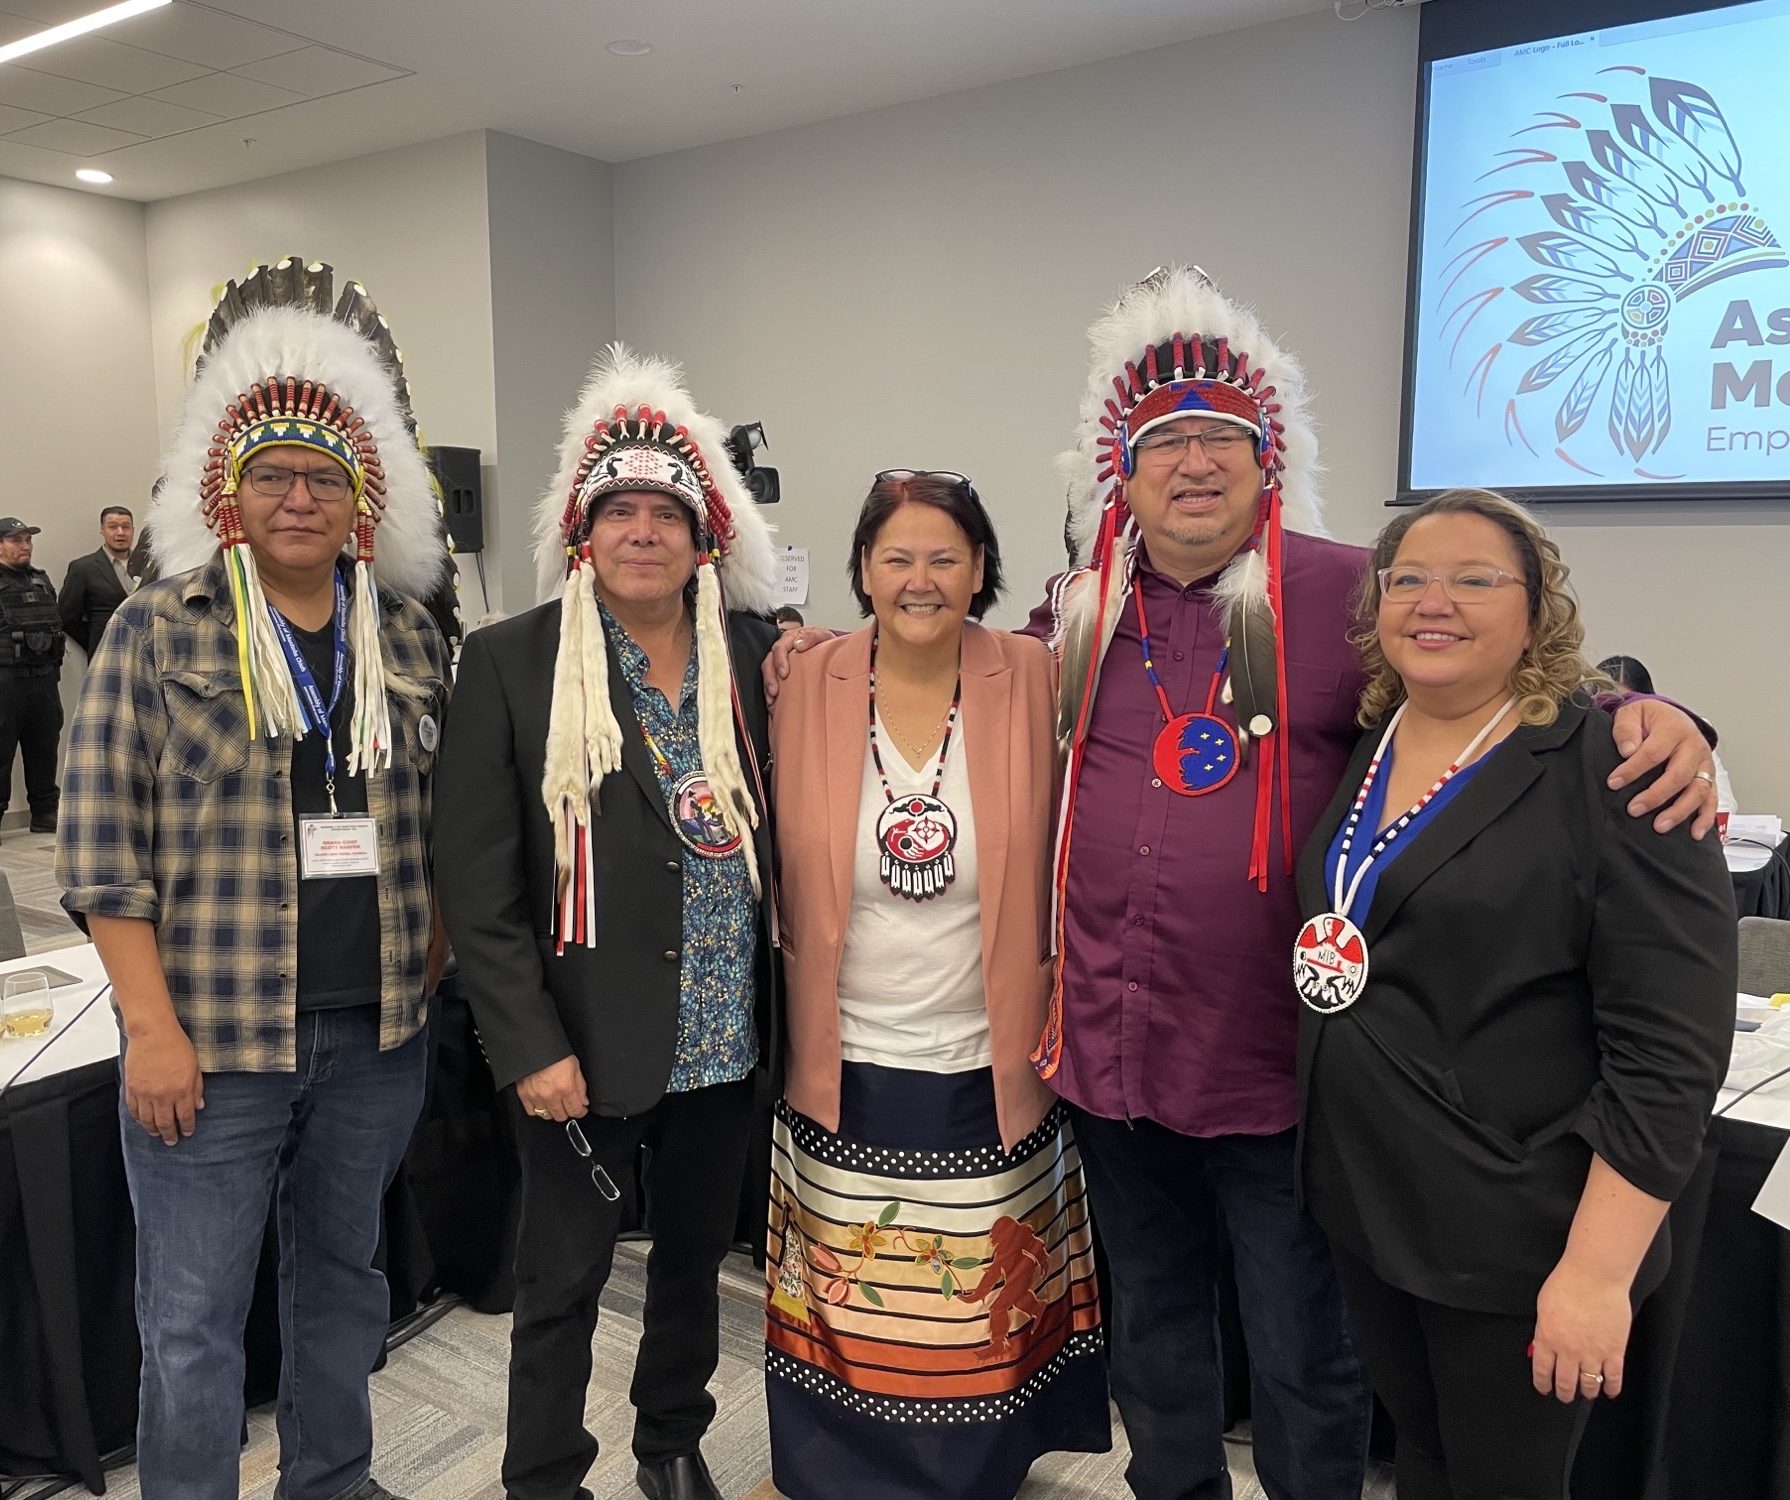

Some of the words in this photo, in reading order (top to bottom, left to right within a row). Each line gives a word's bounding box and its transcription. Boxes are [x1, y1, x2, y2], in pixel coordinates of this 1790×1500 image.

[1532, 45, 1550, 53] Logo
[1557, 40, 1570, 49] Full
[1467, 56, 1487, 65] Tools
[1710, 299, 1790, 349] As
[1706, 426, 1790, 457] Emp
[1317, 949, 1336, 964] MIB
